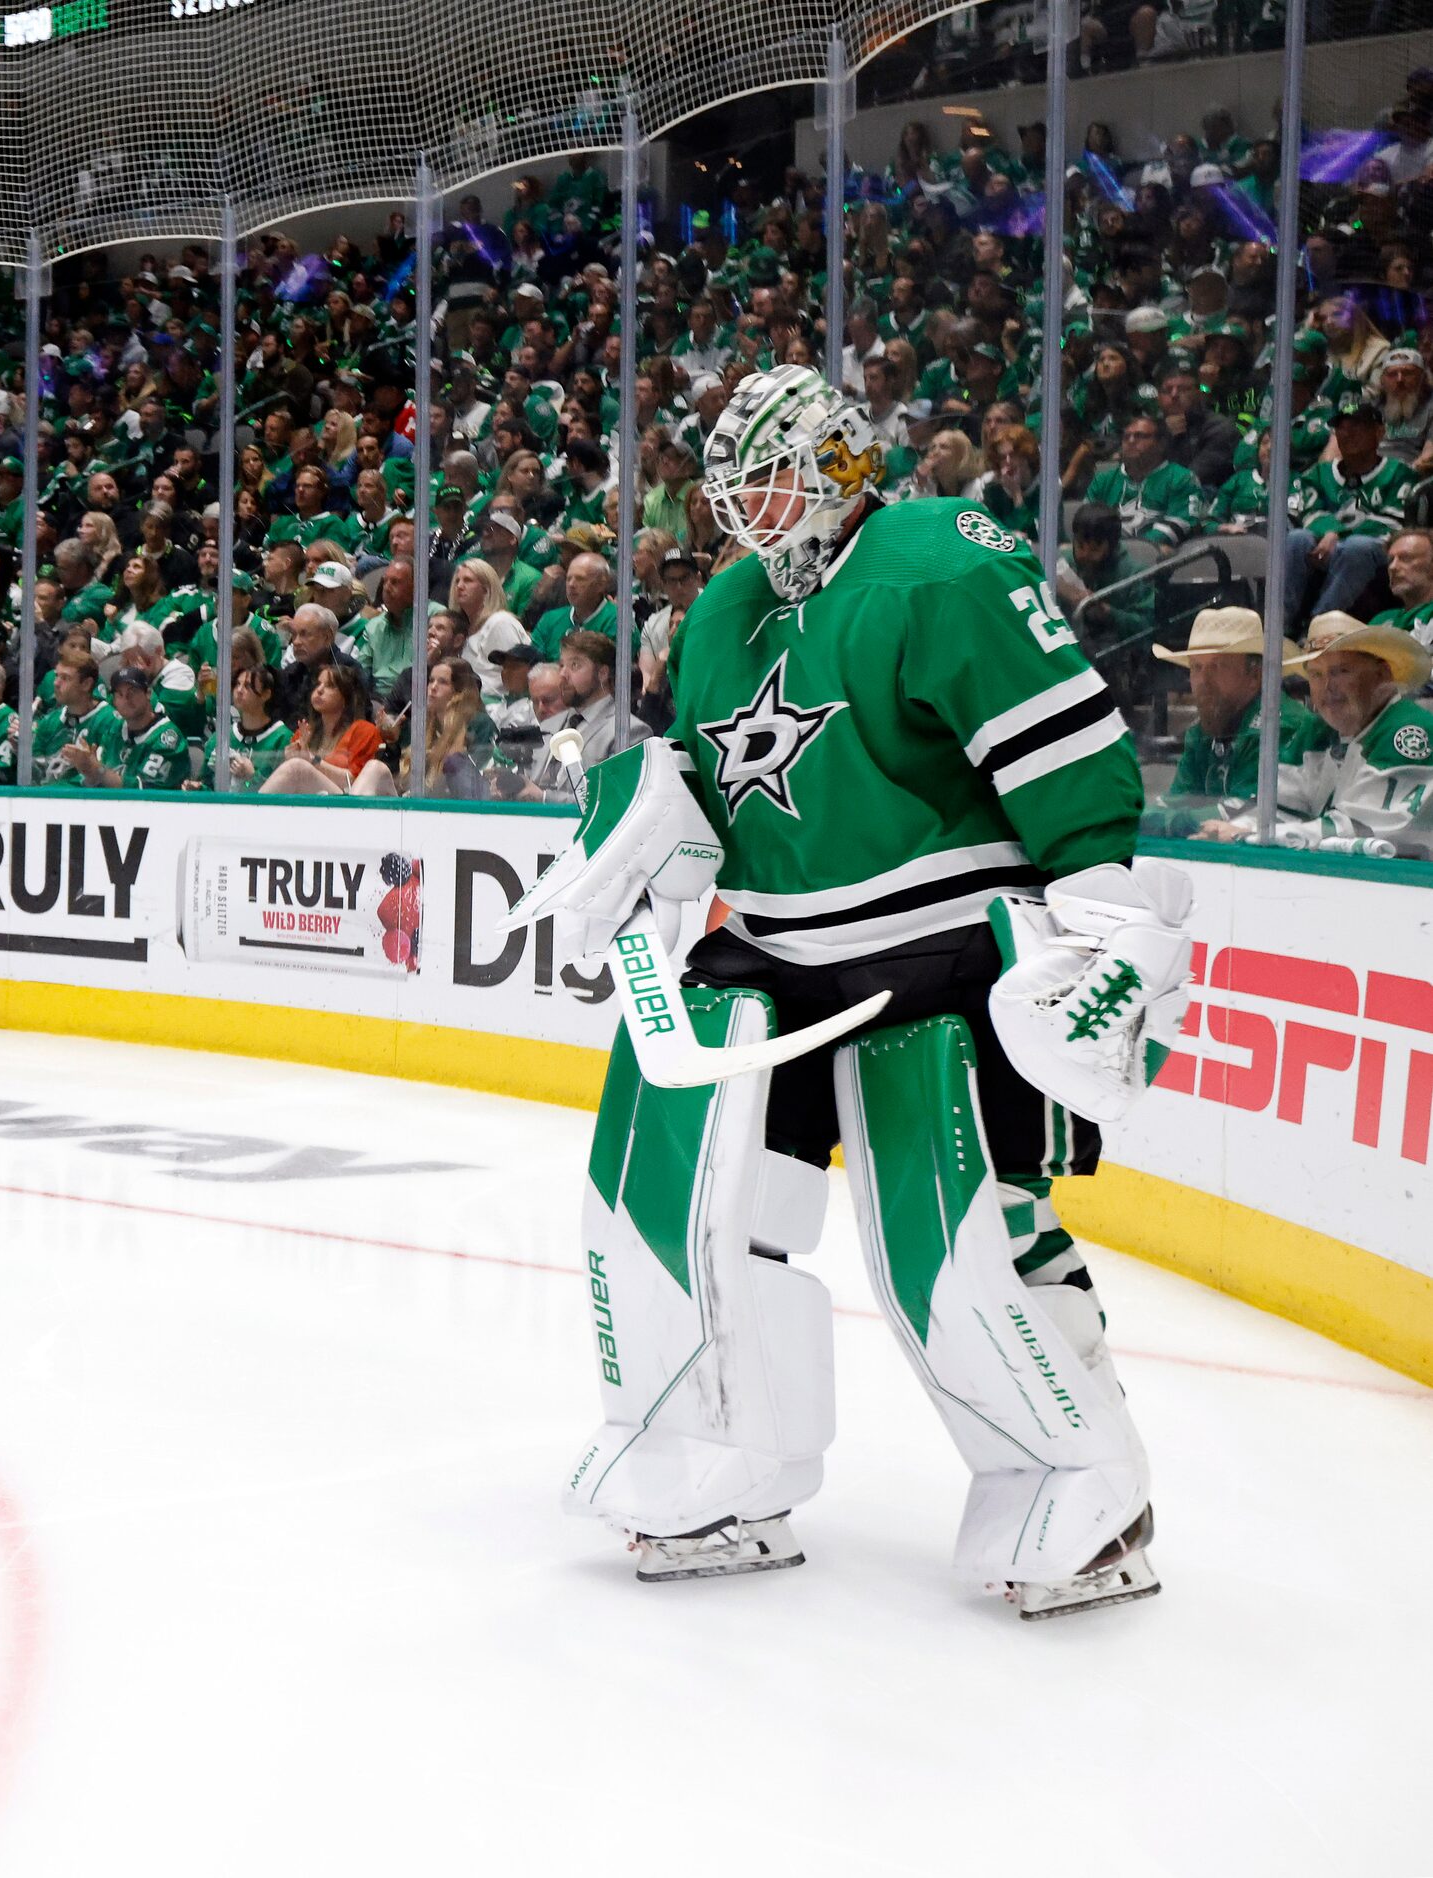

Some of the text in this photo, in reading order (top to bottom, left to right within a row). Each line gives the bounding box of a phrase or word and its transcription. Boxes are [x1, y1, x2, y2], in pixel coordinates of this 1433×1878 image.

[1381, 776, 1426, 816] 14
[677, 846, 719, 862] MACH
[218, 865, 228, 936] HARD SELTZER
[240, 857, 366, 910] TRULY
[299, 913, 341, 934] BERRY
[570, 1446, 600, 1490] MACH
